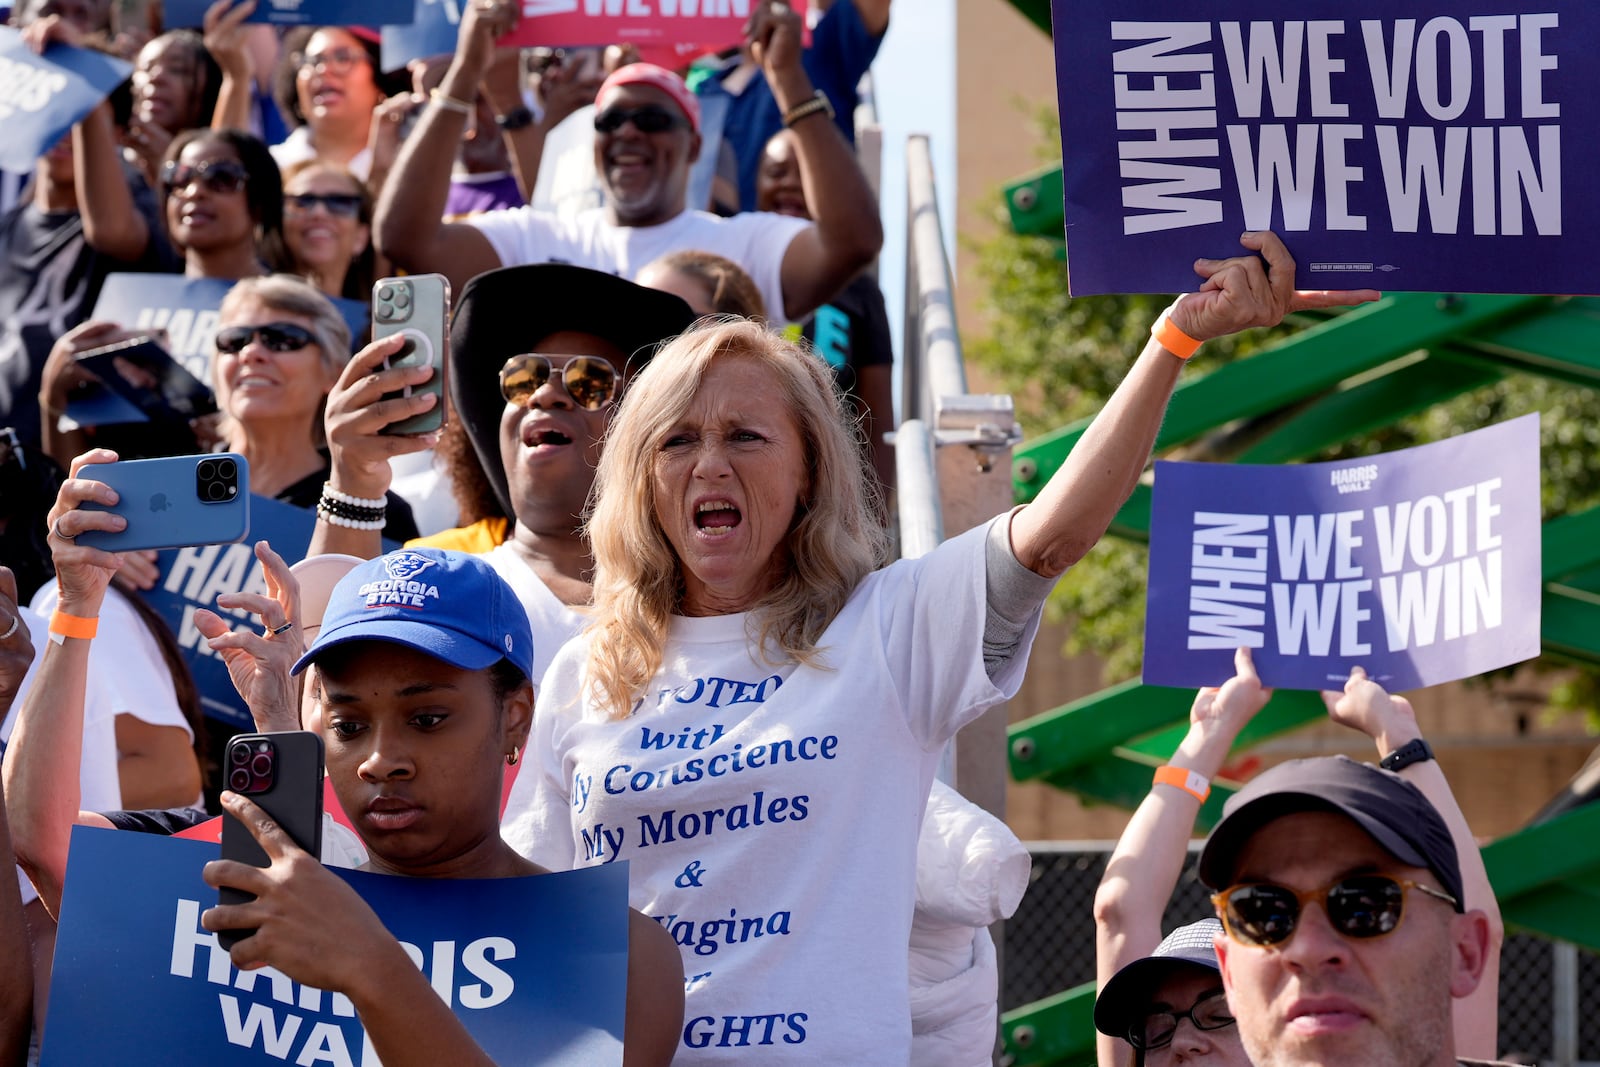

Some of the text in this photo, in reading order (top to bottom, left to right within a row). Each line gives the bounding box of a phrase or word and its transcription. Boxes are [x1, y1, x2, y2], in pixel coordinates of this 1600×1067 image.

[1220, 13, 1561, 121] WE VOTE
[1111, 21, 1223, 235] WHEN
[1226, 124, 1562, 235] WE WIN
[1331, 464, 1378, 486] HARRIS
[1338, 480, 1371, 494] WALZ
[1273, 477, 1502, 581] WE VOTE
[359, 580, 440, 599] GEORGIA
[366, 591, 425, 607] STATE
[1188, 511, 1269, 650] WHEN
[1272, 549, 1502, 657] WE WIN
[604, 735, 838, 795] Conscience
[580, 791, 810, 864] My Morales
[674, 860, 706, 889] &
